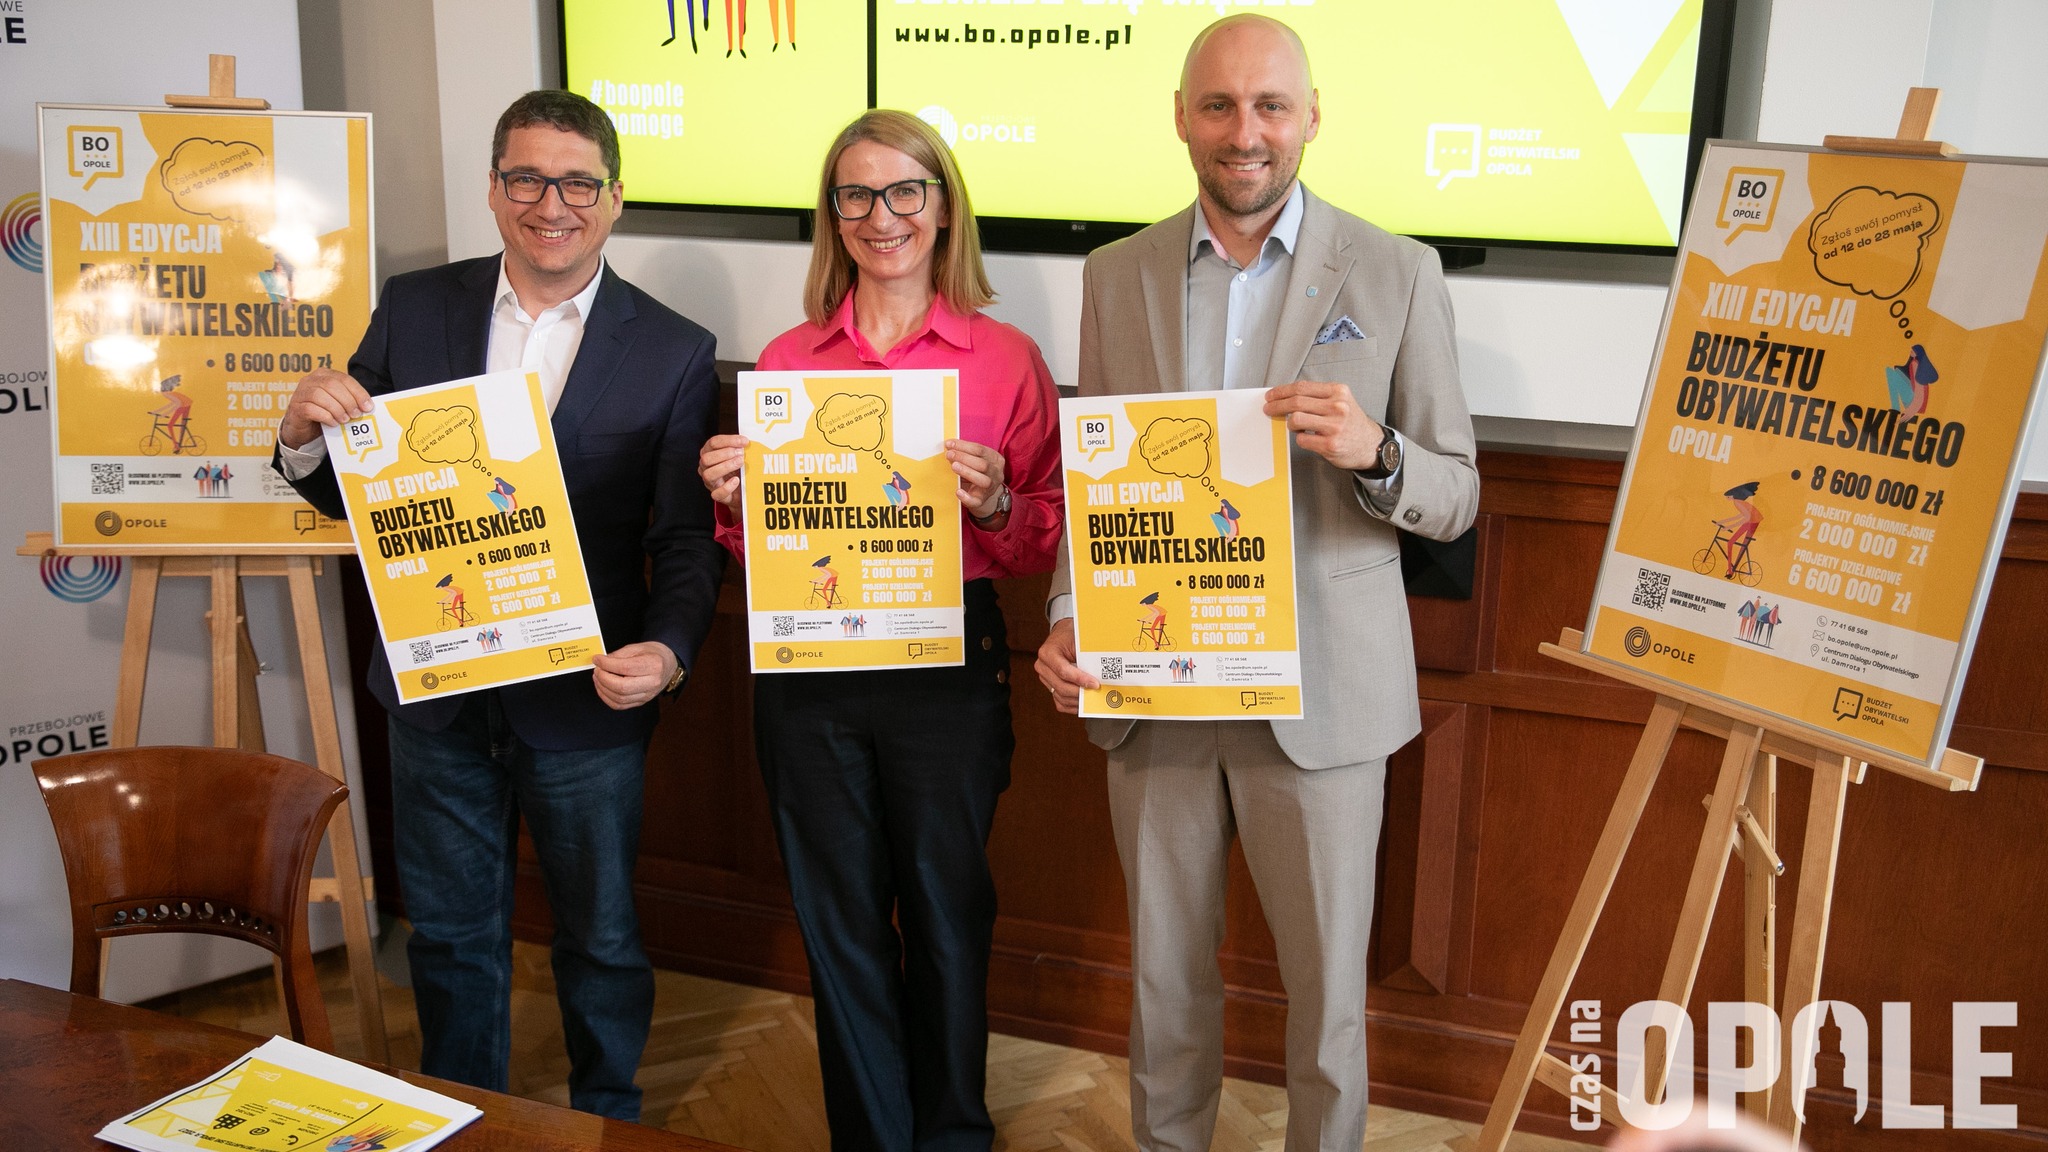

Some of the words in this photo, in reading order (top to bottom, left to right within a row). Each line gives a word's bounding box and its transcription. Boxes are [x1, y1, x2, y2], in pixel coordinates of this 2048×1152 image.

[896, 23, 1131, 50] www.bo.opole.pl
[590, 79, 684, 110] #boopole
[962, 123, 1036, 142] OPOLE
[1489, 128, 1542, 142] BUDŻET
[82, 136, 110, 151] BO
[1487, 145, 1580, 160] OBYWATELSKI
[83, 160, 111, 168] OPOLE
[1486, 163, 1532, 176] OPOLA
[1737, 180, 1768, 198] BO
[1732, 209, 1760, 219] OPOLE
[1821, 228, 1851, 245] Zgłoś
[1854, 217, 1878, 233] swój
[1882, 202, 1923, 224] pomysł
[81, 220, 120, 251] XIII
[129, 222, 222, 254] EDYCJA
[1824, 247, 1837, 259] od
[1840, 242, 1854, 252] 12
[1857, 238, 1871, 248] do
[1874, 230, 1890, 242] 28
[1893, 220, 1922, 236] maja
[1701, 281, 1747, 321] XIII
[1749, 288, 1858, 337] EDYCJA
[224, 352, 235, 372] 8
[240, 352, 274, 372] 600
[278, 353, 312, 373] 000
[1685, 330, 1825, 393] BUDŻETU
[226, 393, 237, 410] 2
[242, 393, 272, 410] 000
[763, 395, 782, 405] BO
[351, 423, 370, 435] BO
[1086, 421, 1105, 433] BO
[1674, 373, 1967, 470] OBYWATELSKIEGO
[227, 429, 238, 447] 6
[242, 430, 272, 447] 600
[355, 439, 374, 447] OPOLE
[1667, 424, 1734, 463] OPOLA
[762, 453, 789, 473] XIII
[794, 453, 858, 473] EDYCJA
[363, 480, 392, 503] XIII
[394, 467, 458, 497] EDYCJA
[763, 476, 847, 505] BUDŻETU
[1088, 483, 1114, 505] XIII
[1119, 480, 1184, 504] EDYCJA
[1810, 465, 1827, 491] 8
[1828, 468, 1872, 501] 600
[1873, 478, 1919, 511] 000
[1920, 487, 1945, 516] zł
[125, 519, 167, 527] OPOLE
[370, 497, 455, 534] BUDŻETU
[764, 505, 934, 530] OBYWATELSKIEGO
[1089, 507, 1173, 538] BUDŻETU
[1805, 501, 1851, 523] PROJEKTY
[1852, 511, 1935, 542] OGÓLNOMIEJSKIE
[377, 505, 546, 559] OBYWATELSKIEGO
[766, 534, 808, 551] OPOLA
[1799, 517, 1814, 539] 2
[1816, 521, 1855, 549] 000
[1858, 531, 1897, 559] 000
[1907, 542, 1929, 567] zł
[477, 552, 486, 565] 8
[487, 547, 512, 563] 600
[513, 542, 537, 558] 000
[538, 539, 551, 553] zł
[859, 539, 867, 553] 8
[870, 539, 893, 553] 600
[896, 539, 919, 552] 000
[922, 538, 933, 552] zł
[1090, 536, 1265, 565] OBYWATELSKIEGO
[385, 557, 428, 578] OPOLA
[861, 567, 869, 578] 2
[872, 567, 892, 578] 000
[896, 566, 916, 578] 000
[923, 566, 933, 577] zł
[1793, 548, 1838, 570] PROJEKTY
[1840, 559, 1902, 586] DZIELNICOWE
[485, 579, 493, 590] 2
[495, 575, 516, 588] 000
[519, 570, 540, 584] 000
[545, 567, 556, 579] zł
[1093, 569, 1135, 587] OPOLA
[1187, 575, 1196, 589] 8
[1198, 574, 1223, 589] 600
[1226, 574, 1250, 589] 000
[1253, 573, 1265, 588] zł
[1787, 563, 1802, 586] 6
[1804, 567, 1842, 596] 600
[1843, 577, 1883, 607] 000
[1890, 589, 1912, 614] zł
[492, 603, 500, 615] 6
[501, 599, 522, 613] 600
[524, 595, 545, 608] 000
[550, 592, 561, 603] zł
[862, 591, 870, 603] 6
[872, 591, 893, 602] 600
[896, 590, 916, 602] 000
[922, 590, 931, 601] zł
[1190, 605, 1197, 617] 2
[1200, 605, 1222, 617] 000
[1226, 604, 1247, 617] 000
[1255, 604, 1266, 617] zł
[1191, 632, 1199, 644] 6
[1202, 631, 1223, 644] 600
[1226, 631, 1248, 644] 000
[1254, 631, 1265, 644] zł
[1829, 620, 1838, 628] 77
[1838, 622, 1847, 630] 41
[1847, 625, 1856, 633] 68
[1855, 627, 1868, 636] 568
[1652, 642, 1695, 664] OPOLE
[1820, 655, 1830, 663] ul.
[1831, 658, 1861, 672] Damrota
[1823, 646, 1849, 659] Centrum
[1848, 653, 1872, 667] Dialogu
[1871, 660, 1920, 681] Obywatelskiego
[439, 671, 467, 681] OPOLE
[1866, 697, 1892, 709] BUDŻET
[9, 710, 105, 737] PRZEBOJOWE
[1862, 714, 1884, 726] OPOLA
[1864, 706, 1908, 724] OBYWATELSKI
[0, 725, 108, 767] POLE
